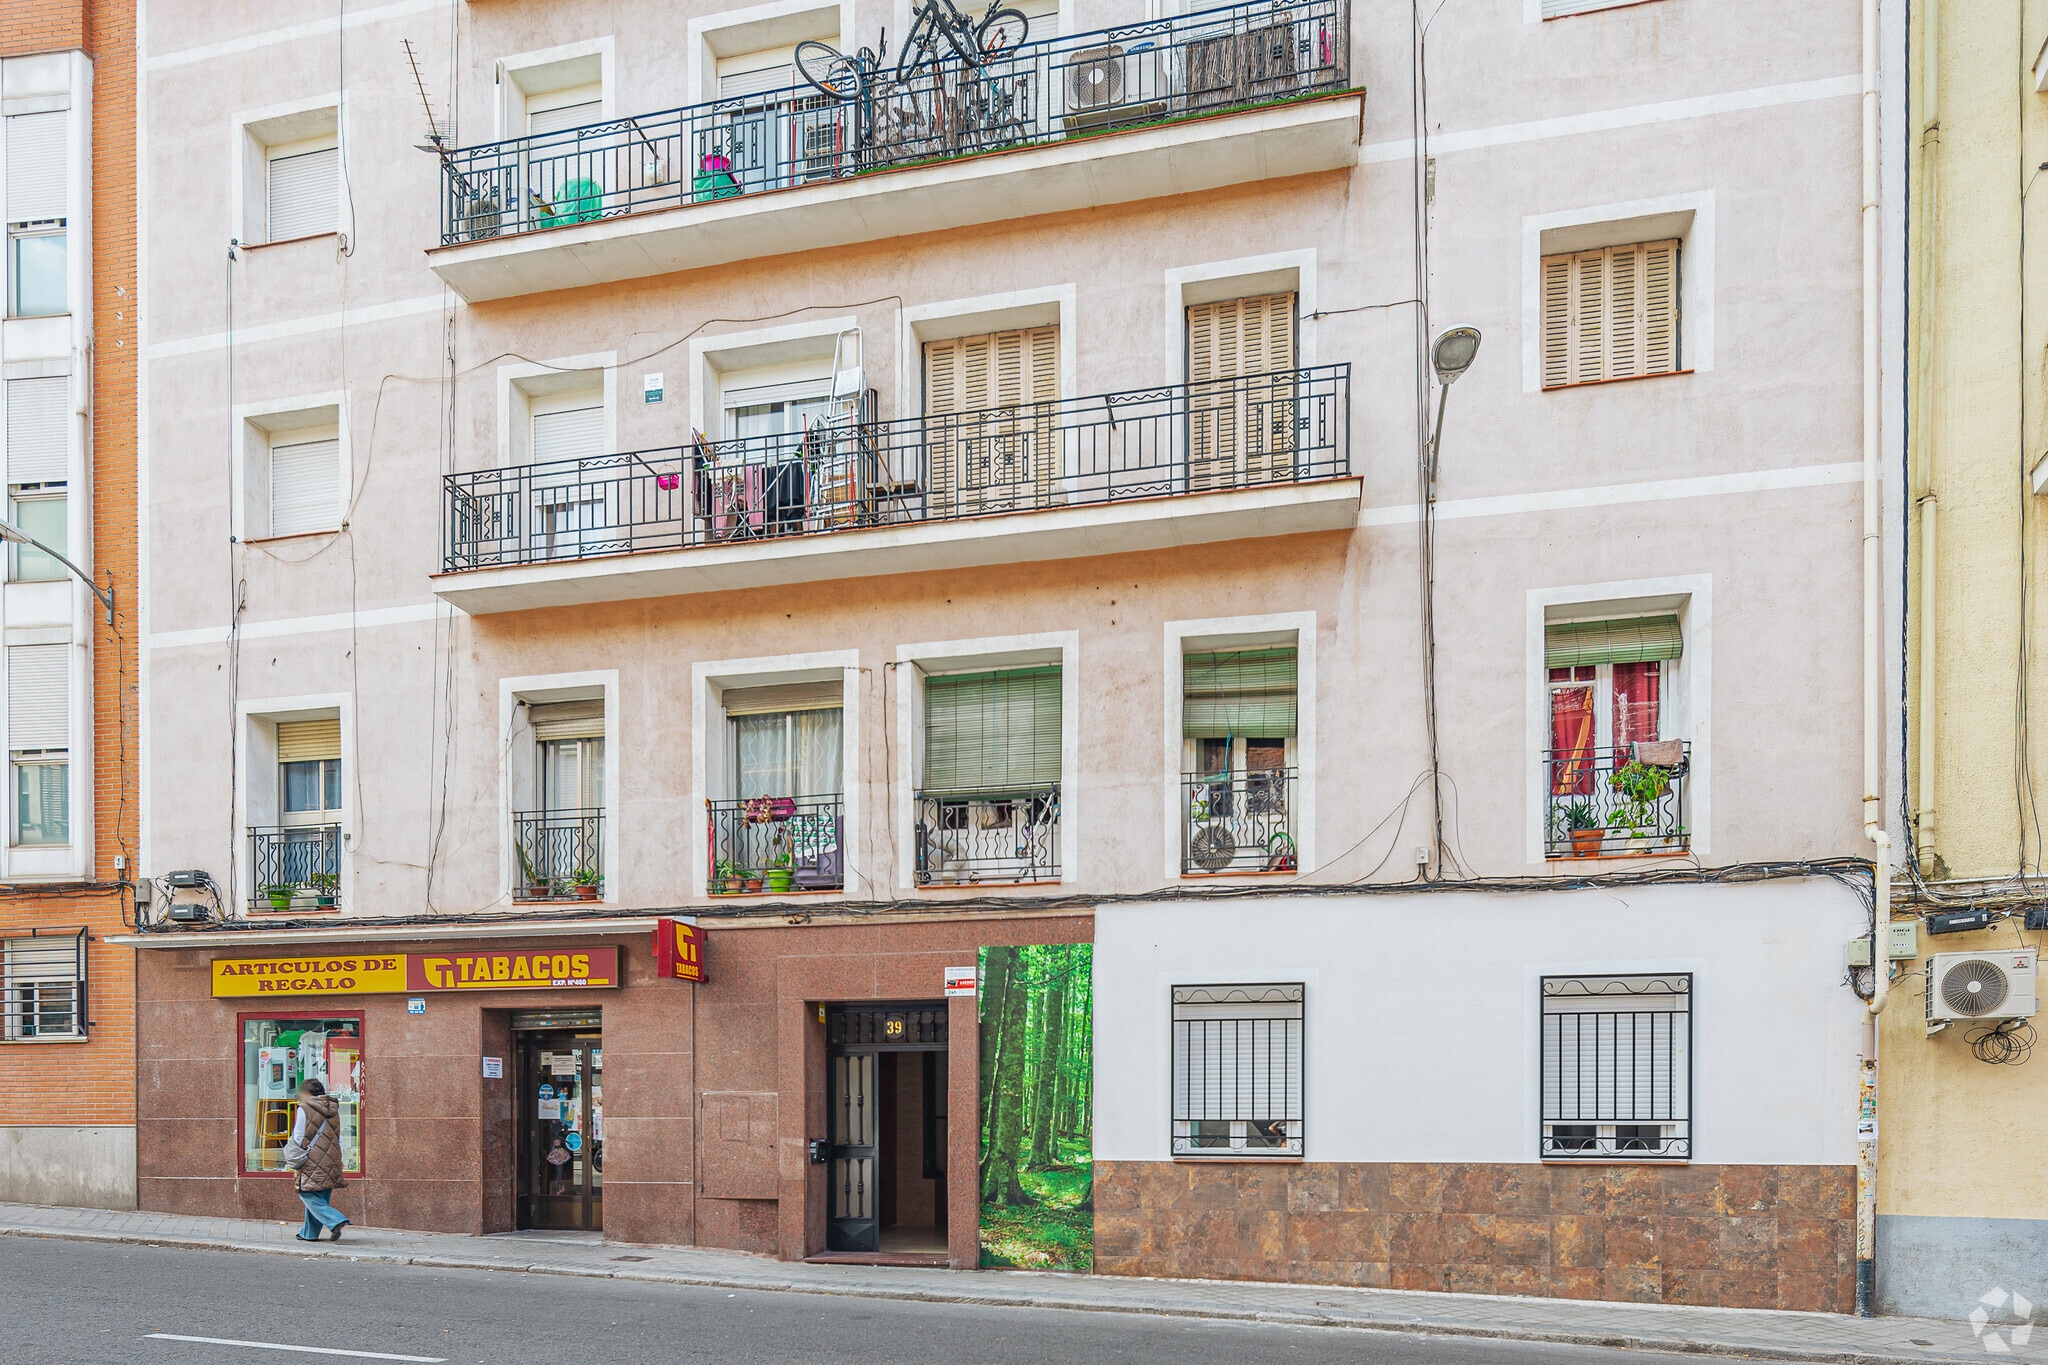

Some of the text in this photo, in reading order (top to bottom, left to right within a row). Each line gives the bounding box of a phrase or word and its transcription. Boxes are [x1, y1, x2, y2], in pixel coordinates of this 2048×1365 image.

[220, 958, 397, 976] ARTICULOS DE
[456, 954, 589, 980] TABACOS
[675, 962, 699, 977] TABACOS
[258, 977, 356, 992] REGALO
[886, 1020, 903, 1035] 39
